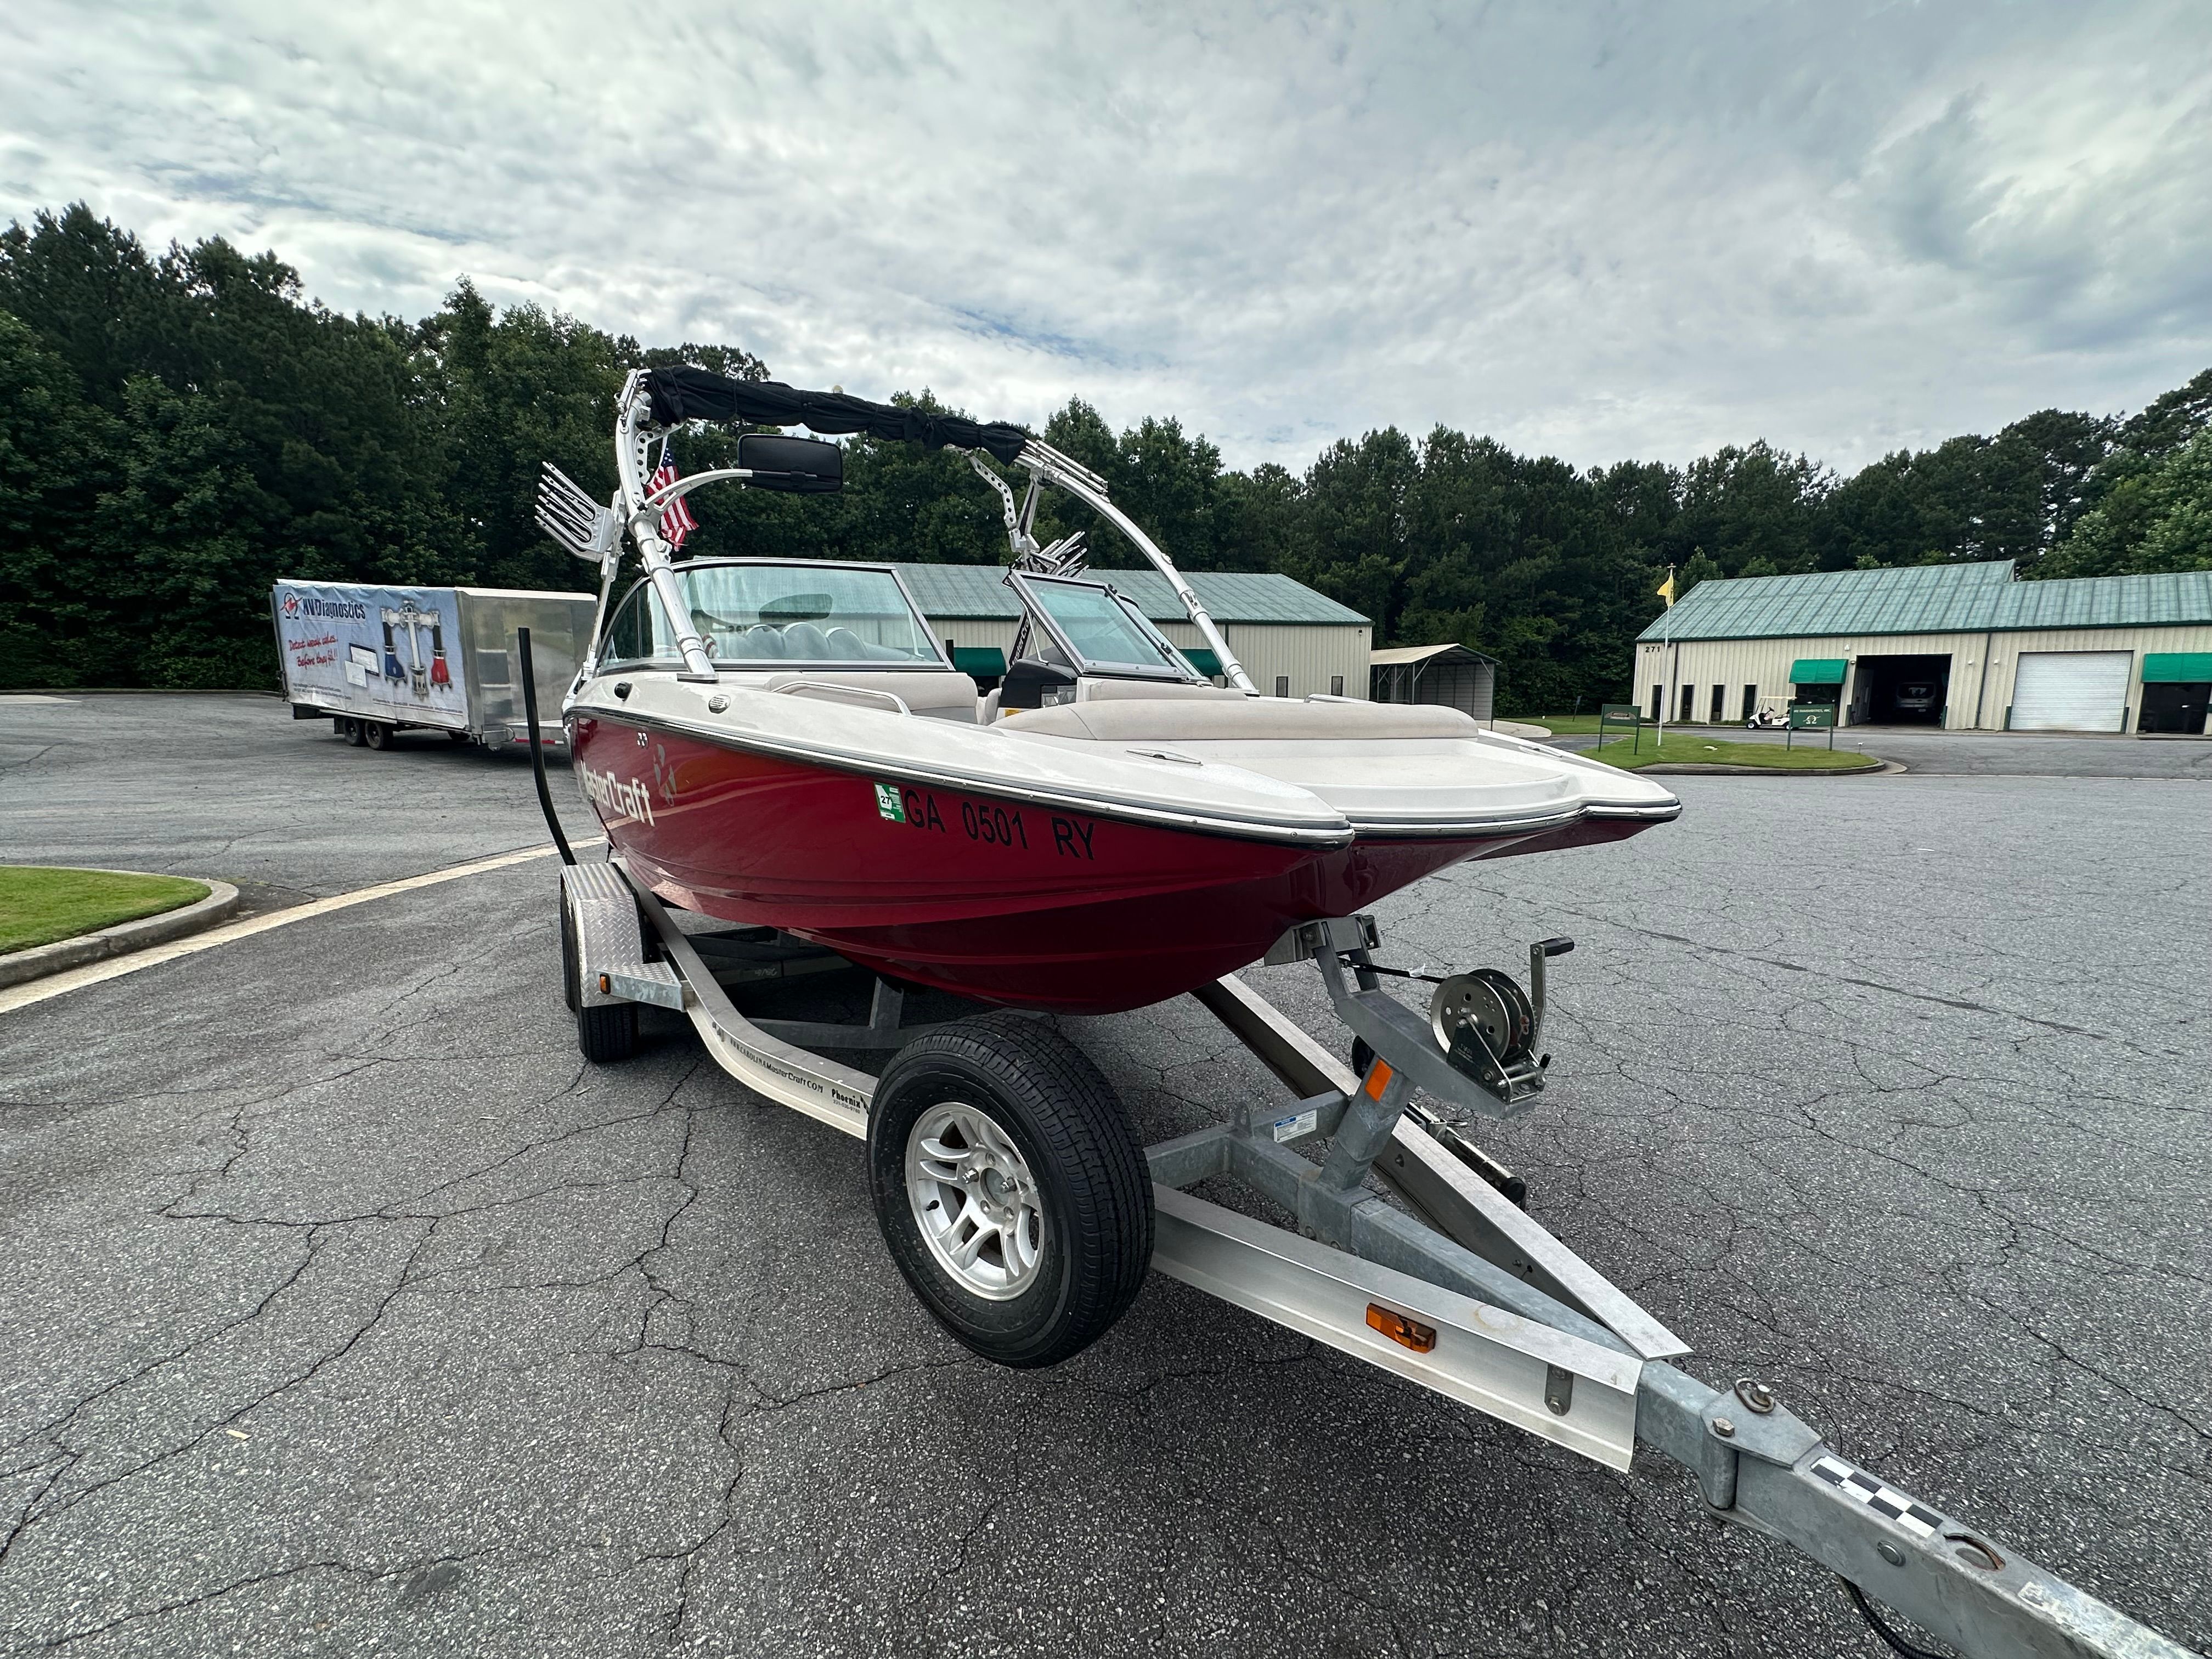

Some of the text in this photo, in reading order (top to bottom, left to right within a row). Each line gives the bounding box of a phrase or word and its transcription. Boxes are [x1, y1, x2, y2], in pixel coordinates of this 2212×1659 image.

[297, 653, 315, 670] Before
[881, 795, 890, 805] 27
[904, 789, 1095, 861] GA 0501 RY
[832, 1088, 861, 1109] Phoenix
